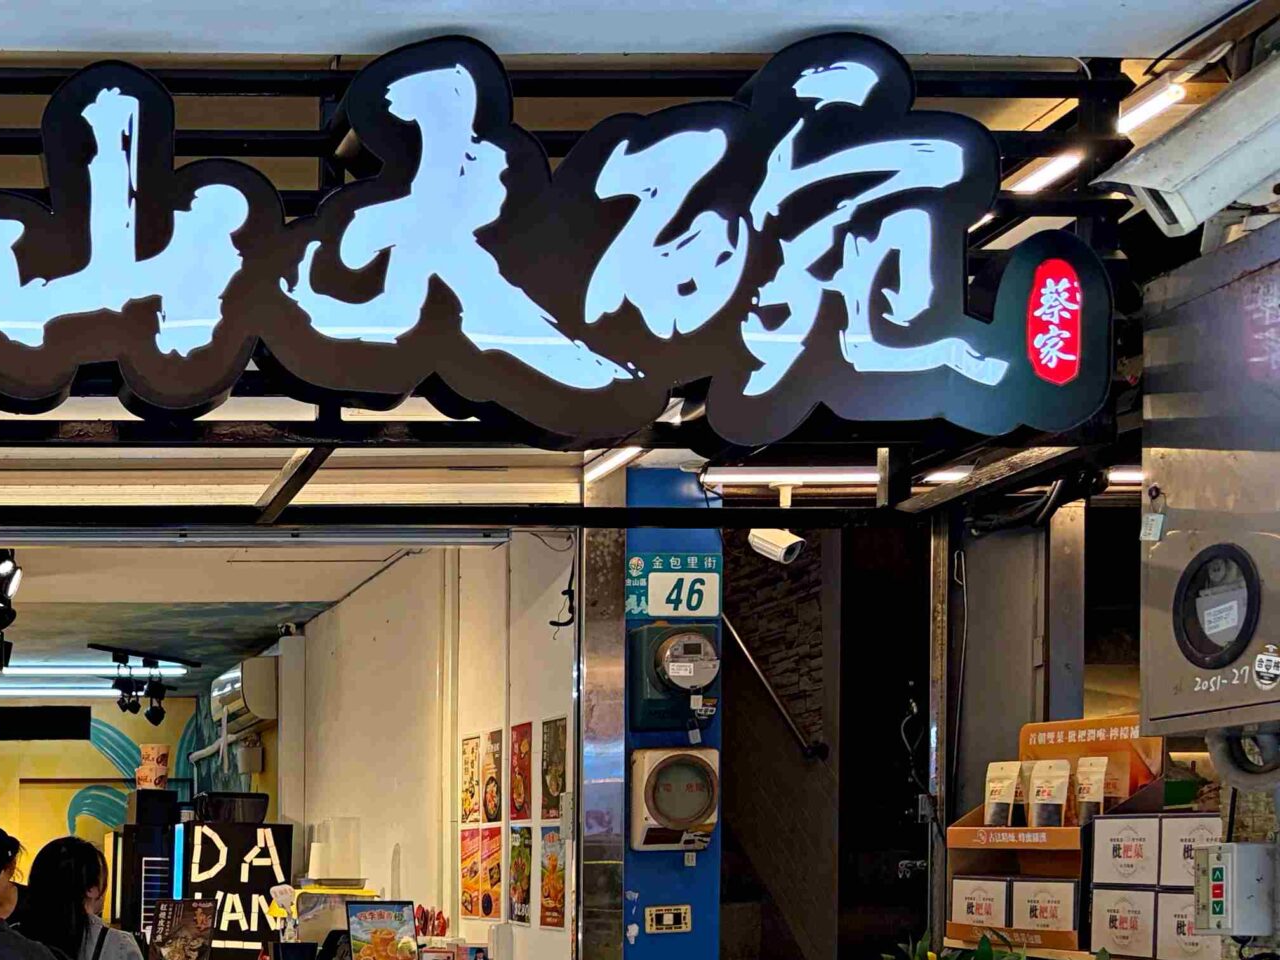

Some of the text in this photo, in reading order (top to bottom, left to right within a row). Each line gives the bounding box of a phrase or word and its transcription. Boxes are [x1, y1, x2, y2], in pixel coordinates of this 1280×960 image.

[1034, 278, 1080, 369] 蔡家
[652, 556, 716, 569] 金包里街
[665, 578, 705, 611] 46
[191, 825, 285, 883] DA
